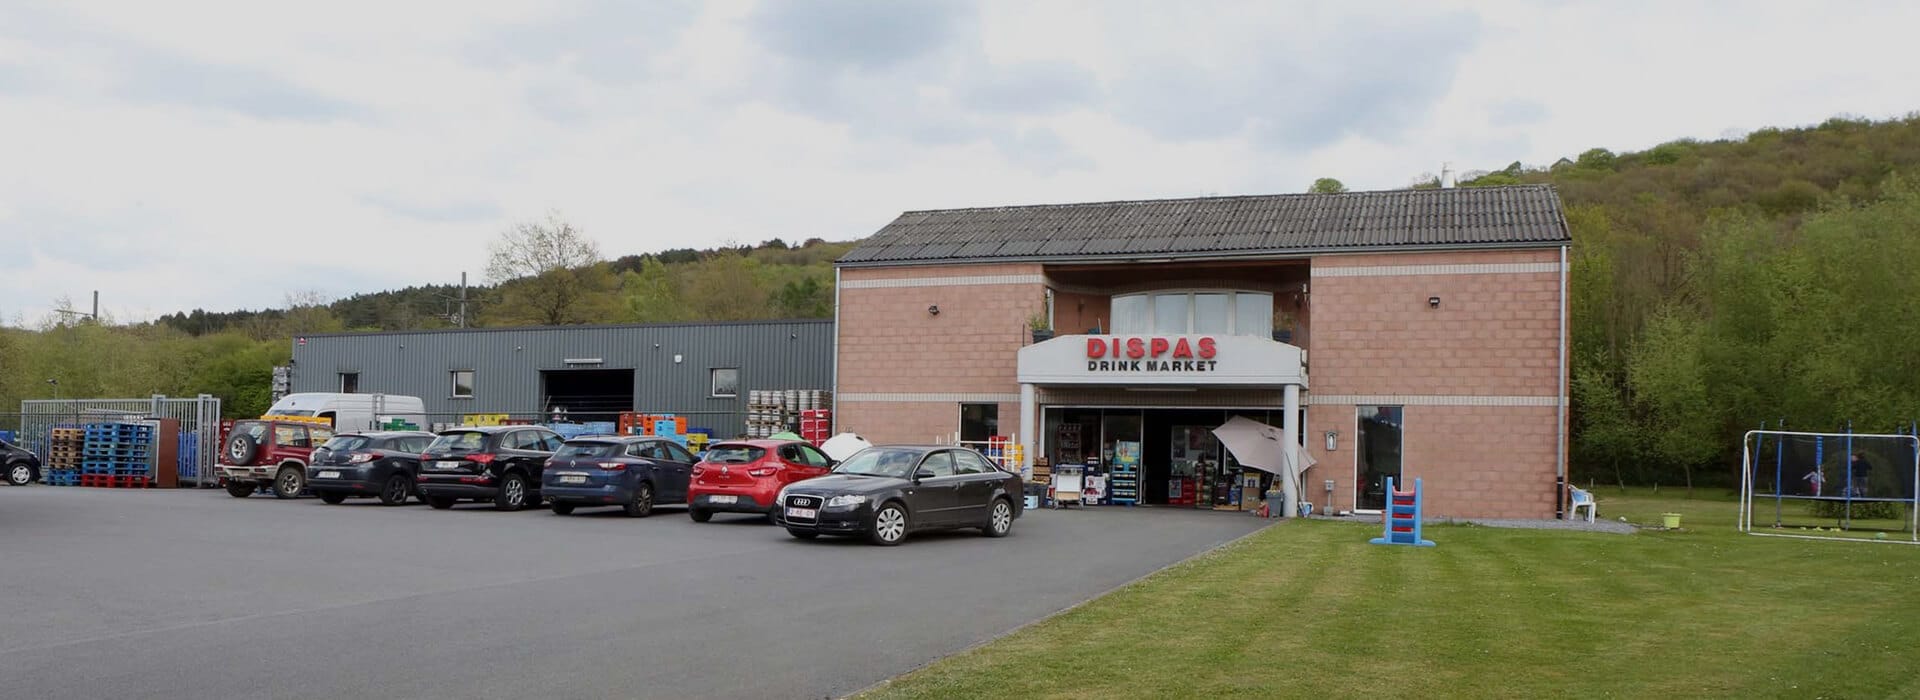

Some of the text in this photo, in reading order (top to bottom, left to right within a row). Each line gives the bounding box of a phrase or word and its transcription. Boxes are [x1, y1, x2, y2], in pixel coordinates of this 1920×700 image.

[1087, 337, 1217, 359] DISPAS
[1088, 361, 1217, 371] DRINK MARKET
